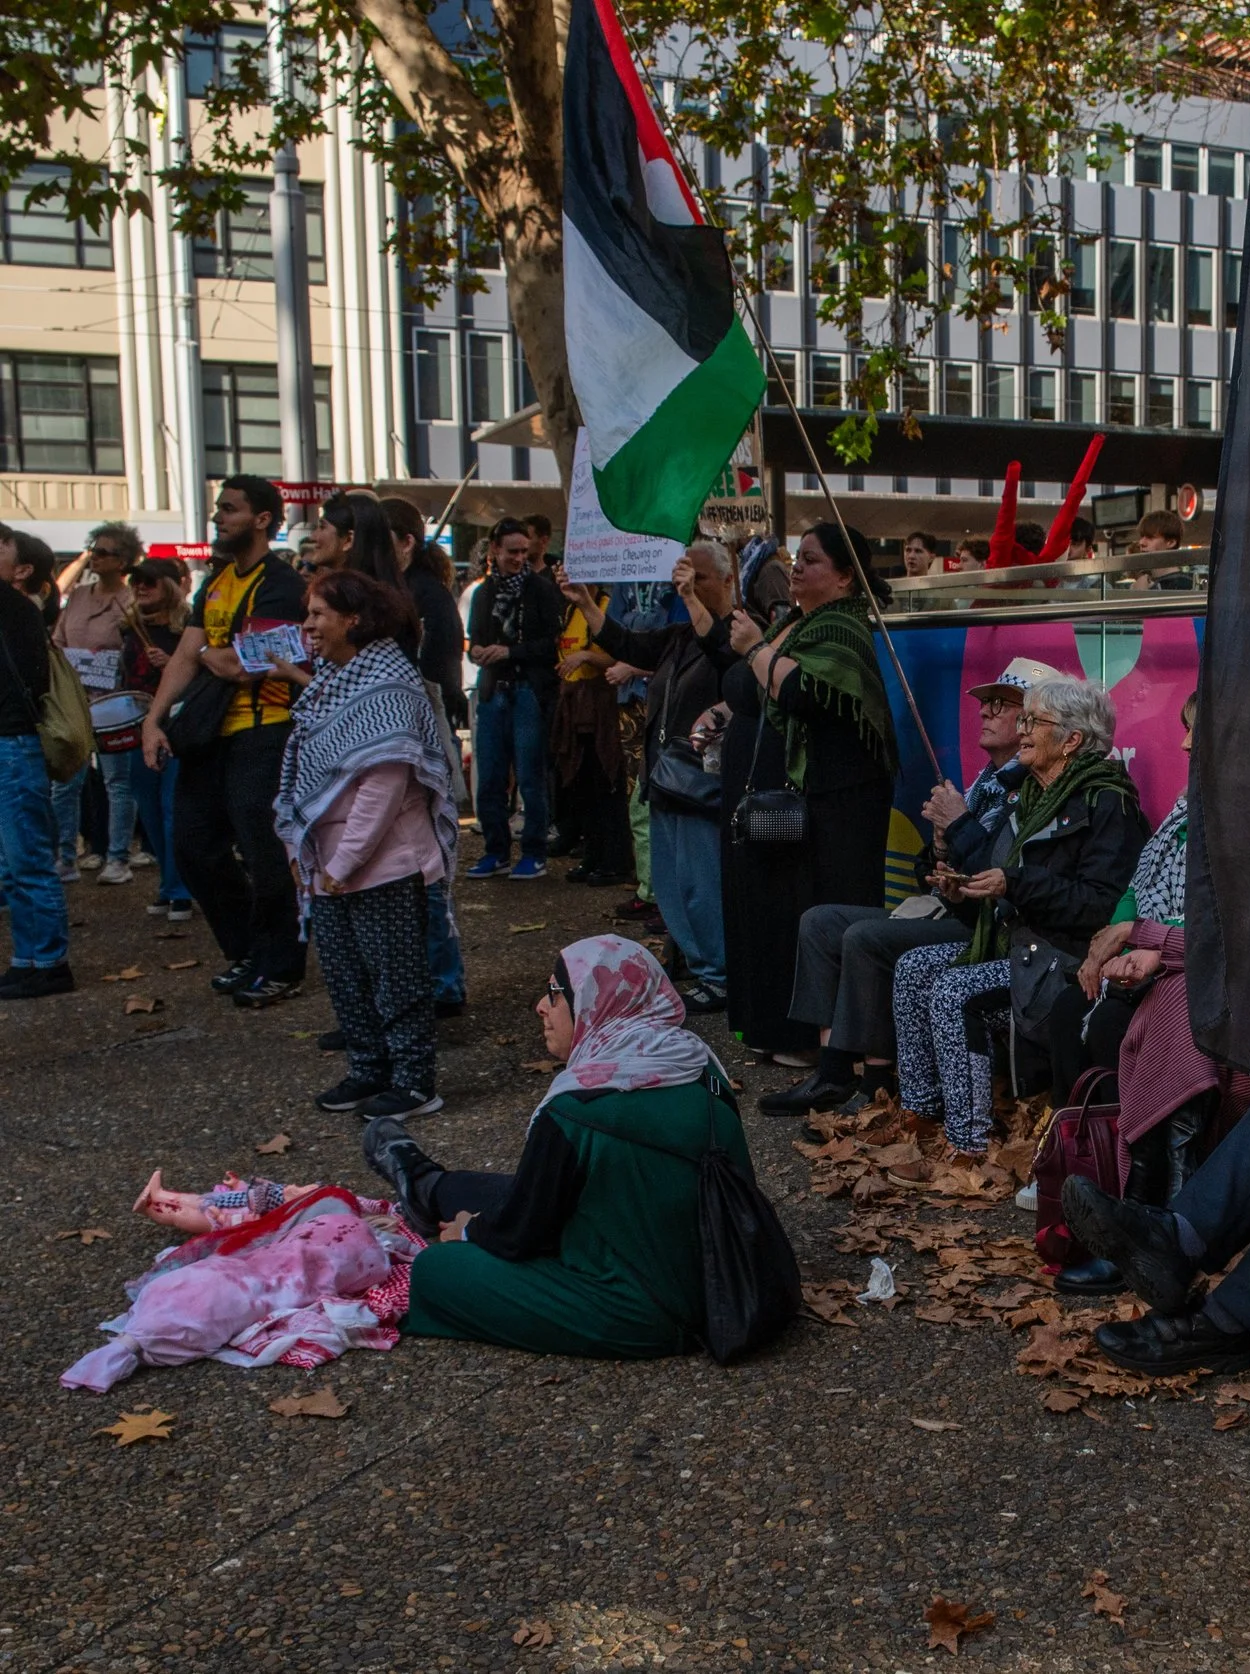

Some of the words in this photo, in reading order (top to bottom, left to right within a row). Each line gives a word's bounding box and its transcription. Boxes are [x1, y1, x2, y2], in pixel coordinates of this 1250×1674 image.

[279, 487, 310, 500] own
[174, 545, 203, 557] Town
[622, 547, 652, 563] Chewing
[652, 548, 663, 559] on
[621, 563, 637, 577] BBQ
[637, 563, 657, 575] limbs
